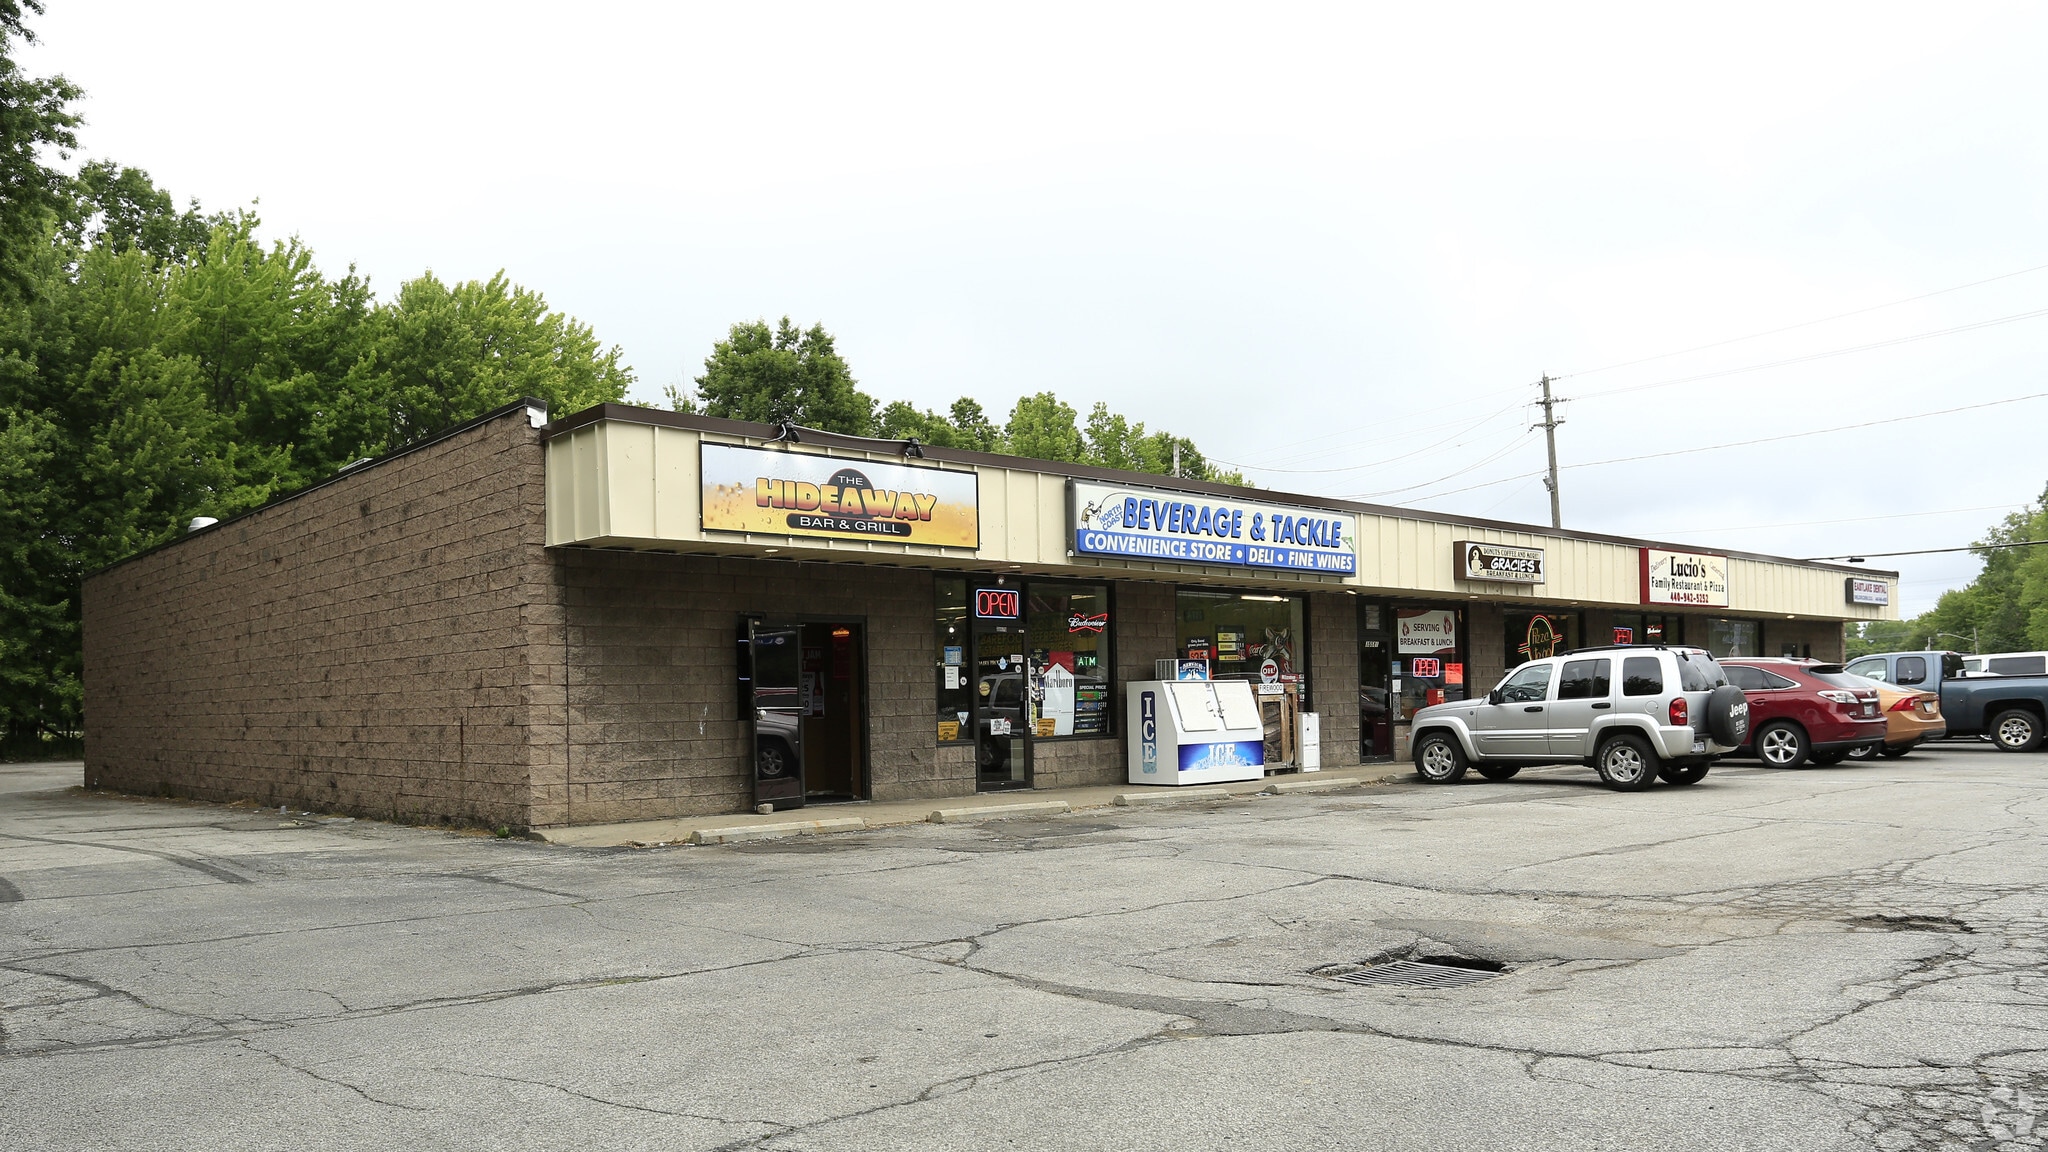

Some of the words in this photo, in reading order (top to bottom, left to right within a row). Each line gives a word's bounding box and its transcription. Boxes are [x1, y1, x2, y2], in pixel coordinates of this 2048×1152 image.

[838, 475, 863, 486] THE
[756, 478, 937, 521] HIDEAWAY
[1100, 504, 1122, 524] NORTH
[1102, 513, 1123, 531] COAST
[1122, 496, 1243, 539] BEVERAGE
[1250, 512, 1266, 542] &
[1272, 514, 1342, 548] TACKLE
[800, 516, 833, 529] BAR
[840, 519, 850, 530] &
[855, 521, 900, 534] GRILL
[1084, 532, 1187, 559] CONVENIENCE
[1190, 545, 1231, 561] STORE
[1249, 548, 1274, 564] DELI
[1288, 552, 1315, 567] FINE
[1317, 554, 1353, 570] WINES
[1484, 547, 1500, 555] DONUTS
[1501, 549, 1517, 557] COFFEE
[1490, 558, 1535, 572] GRACIE'S
[1670, 556, 1706, 578] Lucio's
[1486, 570, 1513, 578] BREAKFAST
[1652, 577, 1670, 591] Family
[1671, 578, 1703, 591] Restaurant
[1704, 581, 1708, 591] &
[1709, 581, 1725, 593] Pizza
[978, 592, 1017, 616] OPEN
[1670, 592, 1709, 603] 440-942-5252
[1068, 617, 1107, 627] Budweiser
[1413, 623, 1440, 632] SERVING
[1400, 638, 1430, 646] BREAKFAST
[1431, 638, 1435, 646] &
[1531, 628, 1550, 644] Pizza
[1078, 656, 1096, 666] ATM
[1414, 659, 1438, 676] OPEN
[1262, 666, 1276, 675] OIL!
[1045, 670, 1072, 688] Marlboro
[1259, 684, 1283, 692] FIREWOOD
[1729, 702, 1748, 718] Jeep
[1142, 697, 1156, 763] ICE
[1208, 743, 1236, 767] ICE
